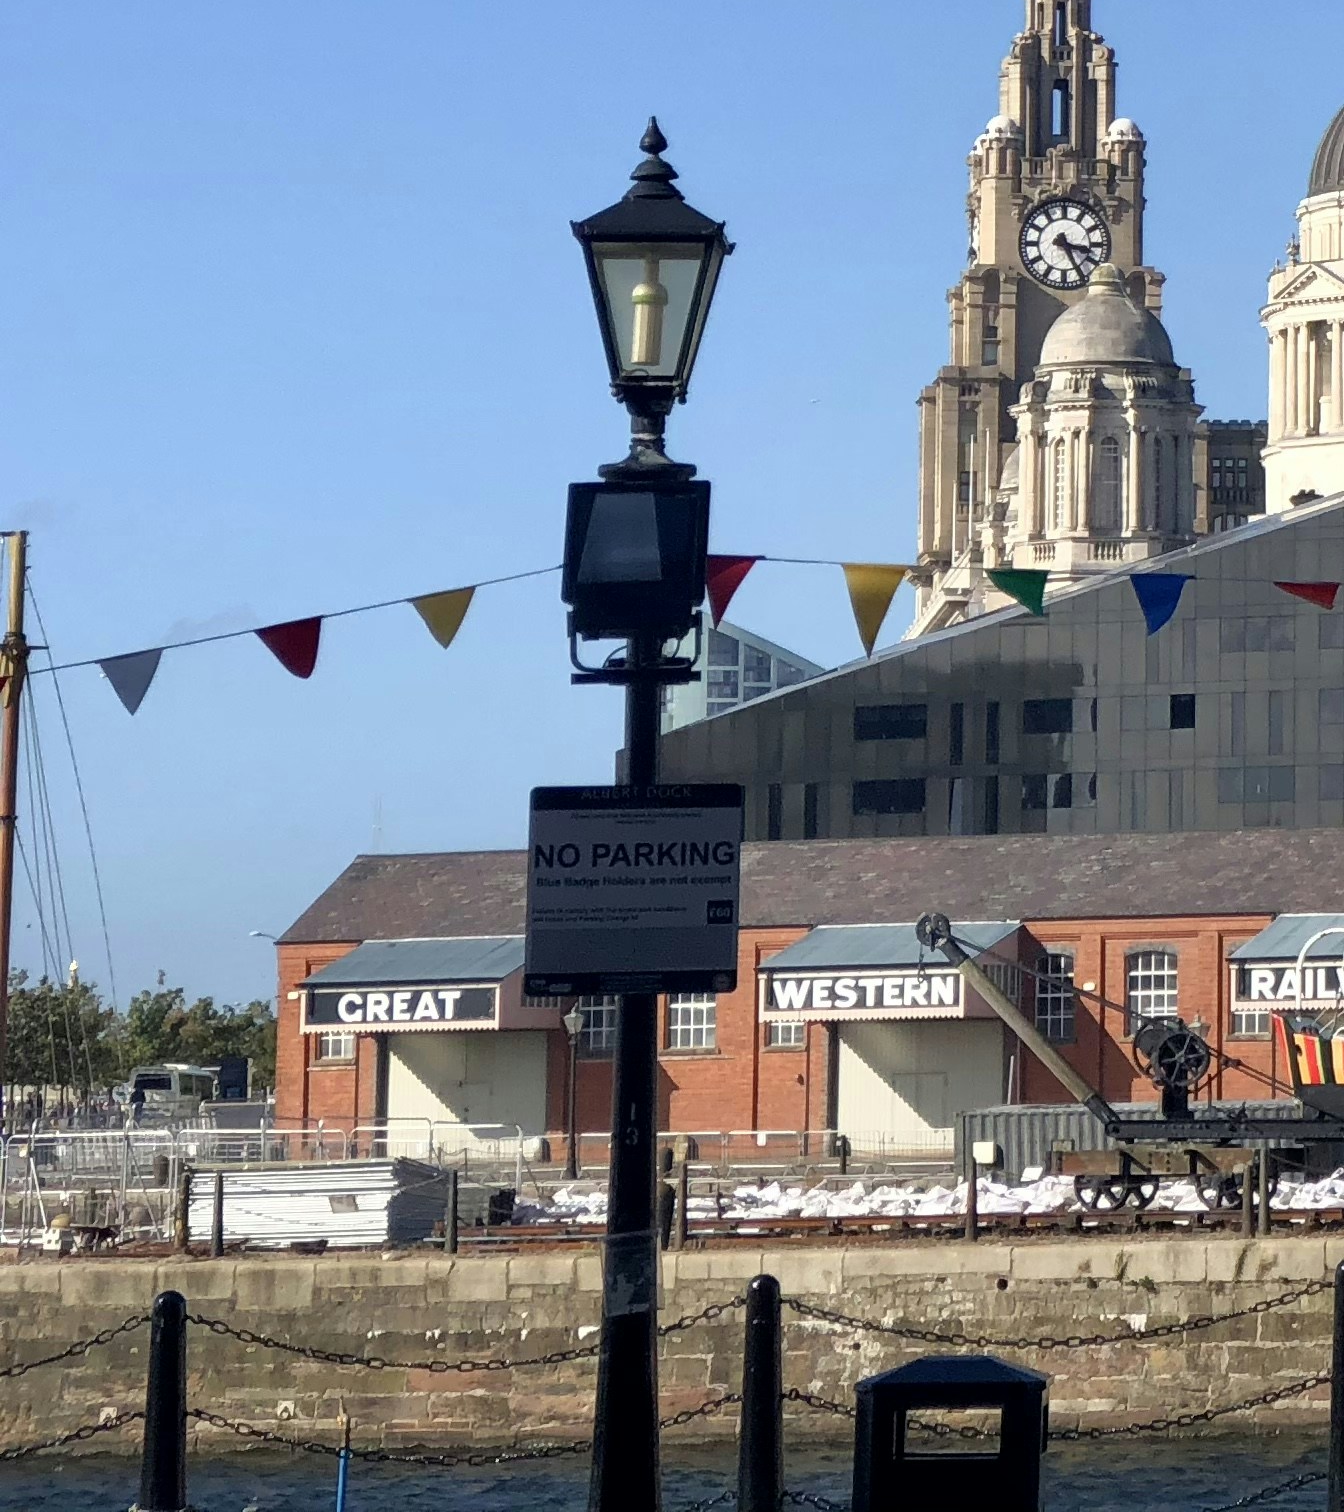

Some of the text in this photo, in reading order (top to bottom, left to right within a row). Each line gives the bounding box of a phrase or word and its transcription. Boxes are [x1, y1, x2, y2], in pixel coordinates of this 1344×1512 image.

[534, 840, 735, 869] NO PARKING
[565, 877, 600, 890] Badge
[338, 991, 461, 1023] GREAT
[773, 976, 954, 1009] WESTERN
